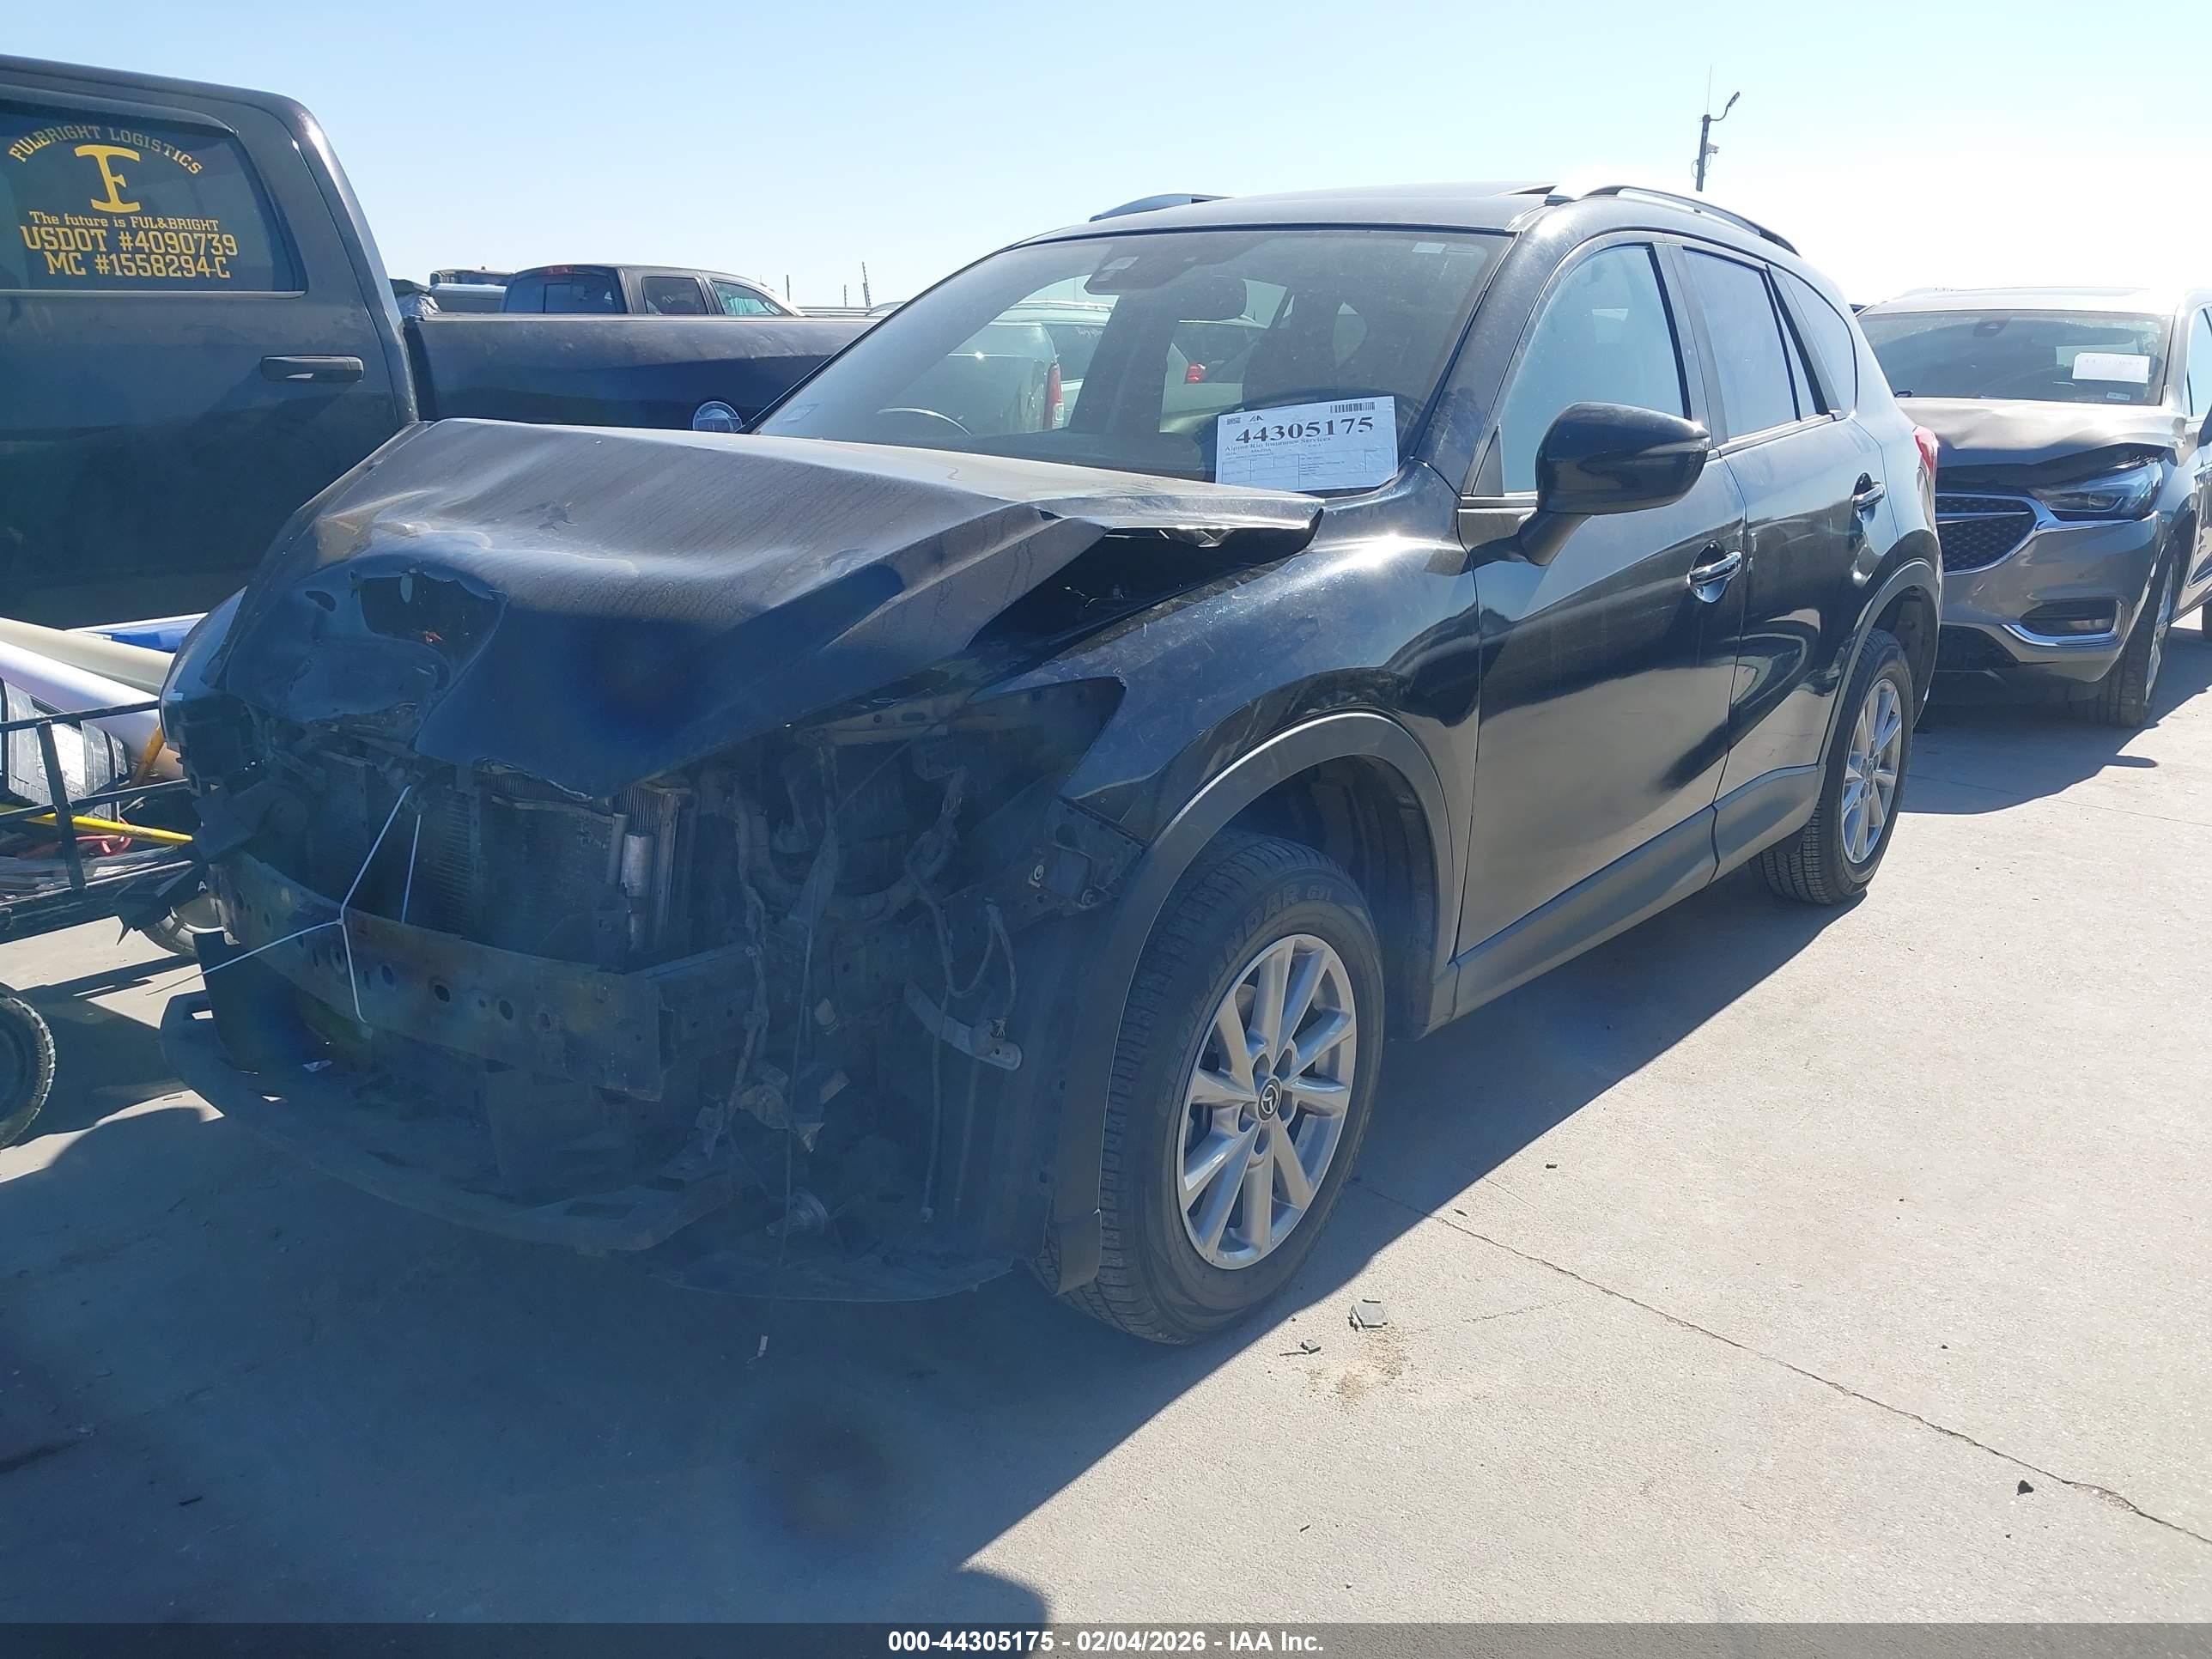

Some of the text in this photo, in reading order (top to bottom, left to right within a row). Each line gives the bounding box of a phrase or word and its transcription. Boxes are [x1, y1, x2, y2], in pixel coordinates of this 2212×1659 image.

[9, 125, 203, 174] FULBRIGHT LOGISTICS
[28, 210, 219, 231] The future is FUL&BRIGHT
[21, 225, 239, 256] USDOT #4090739
[44, 251, 231, 278] MC #1558294-C
[1235, 416, 1374, 444] 44305175
[1300, 436, 1331, 445] Services
